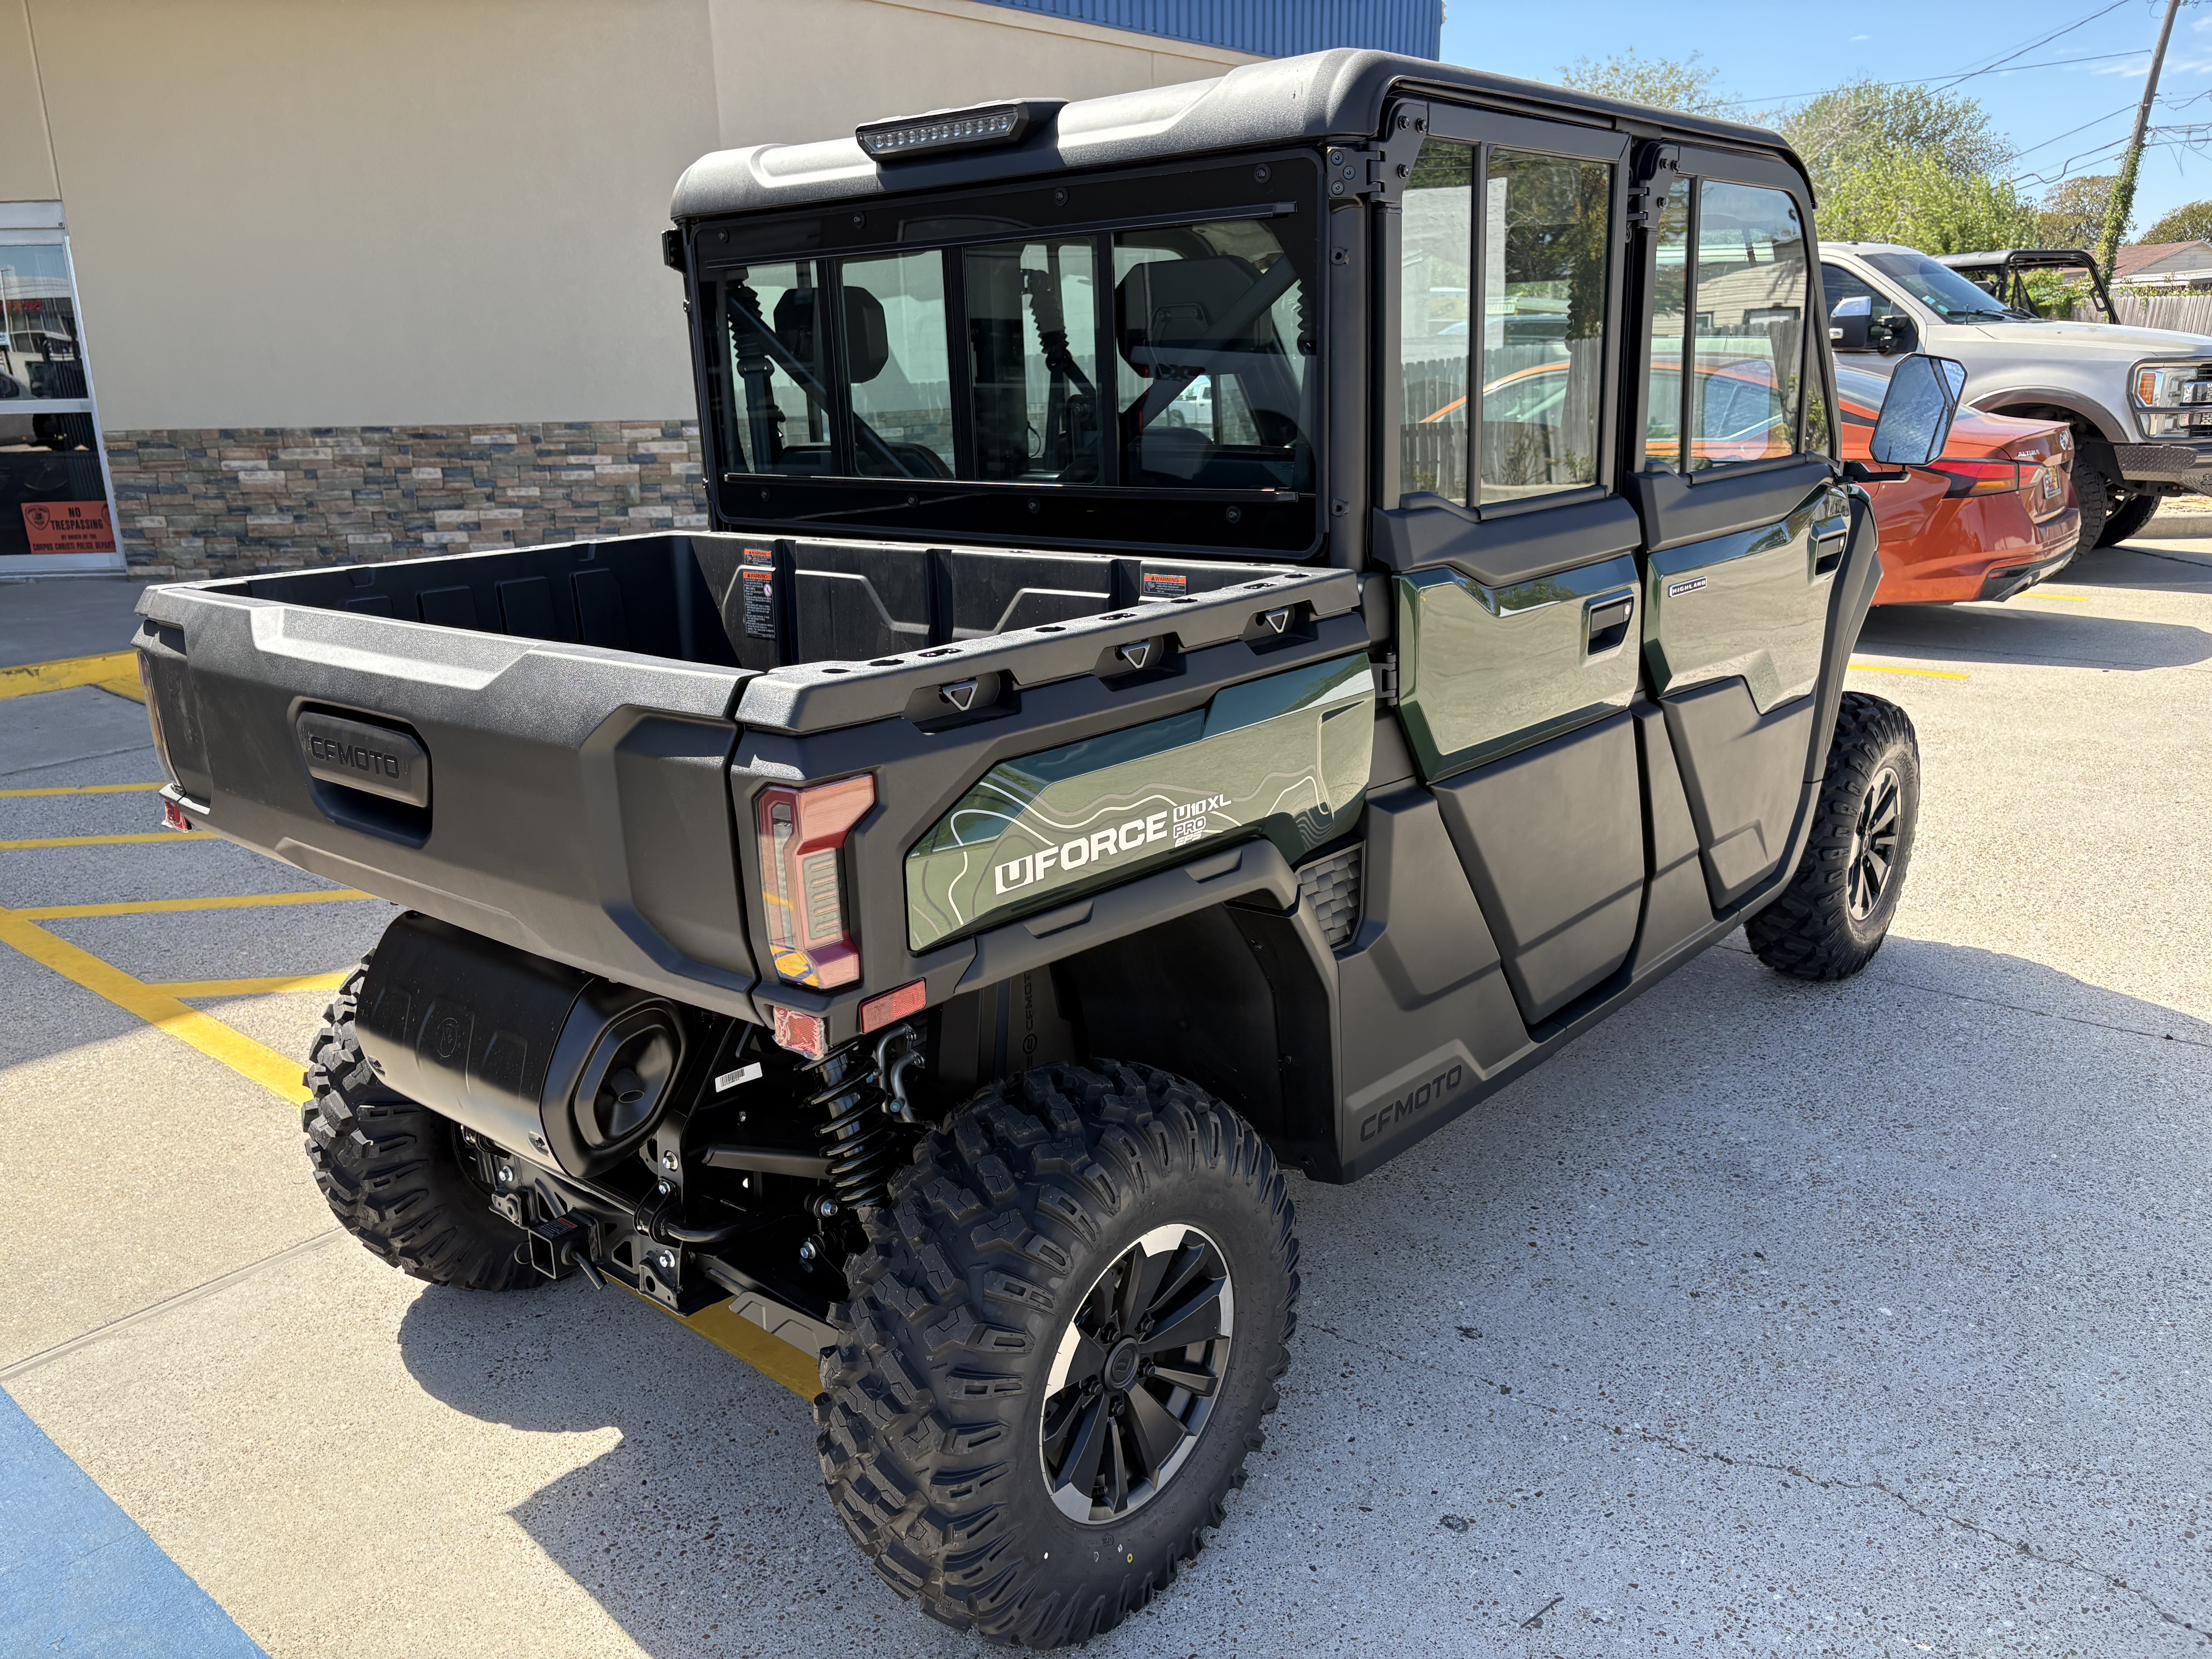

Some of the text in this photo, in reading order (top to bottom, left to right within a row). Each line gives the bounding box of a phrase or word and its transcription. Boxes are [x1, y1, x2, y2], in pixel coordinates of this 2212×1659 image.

[68, 507, 81, 517] NO
[50, 519, 103, 530] TRESPASSING
[1672, 580, 1705, 594] HIGHLAND
[311, 736, 399, 779] CFMOTO
[1173, 816, 1206, 839] PRO
[1175, 830, 1203, 848] EPS
[994, 811, 1167, 895] UFORCE
[1360, 1065, 1462, 1142] CFMOTO
